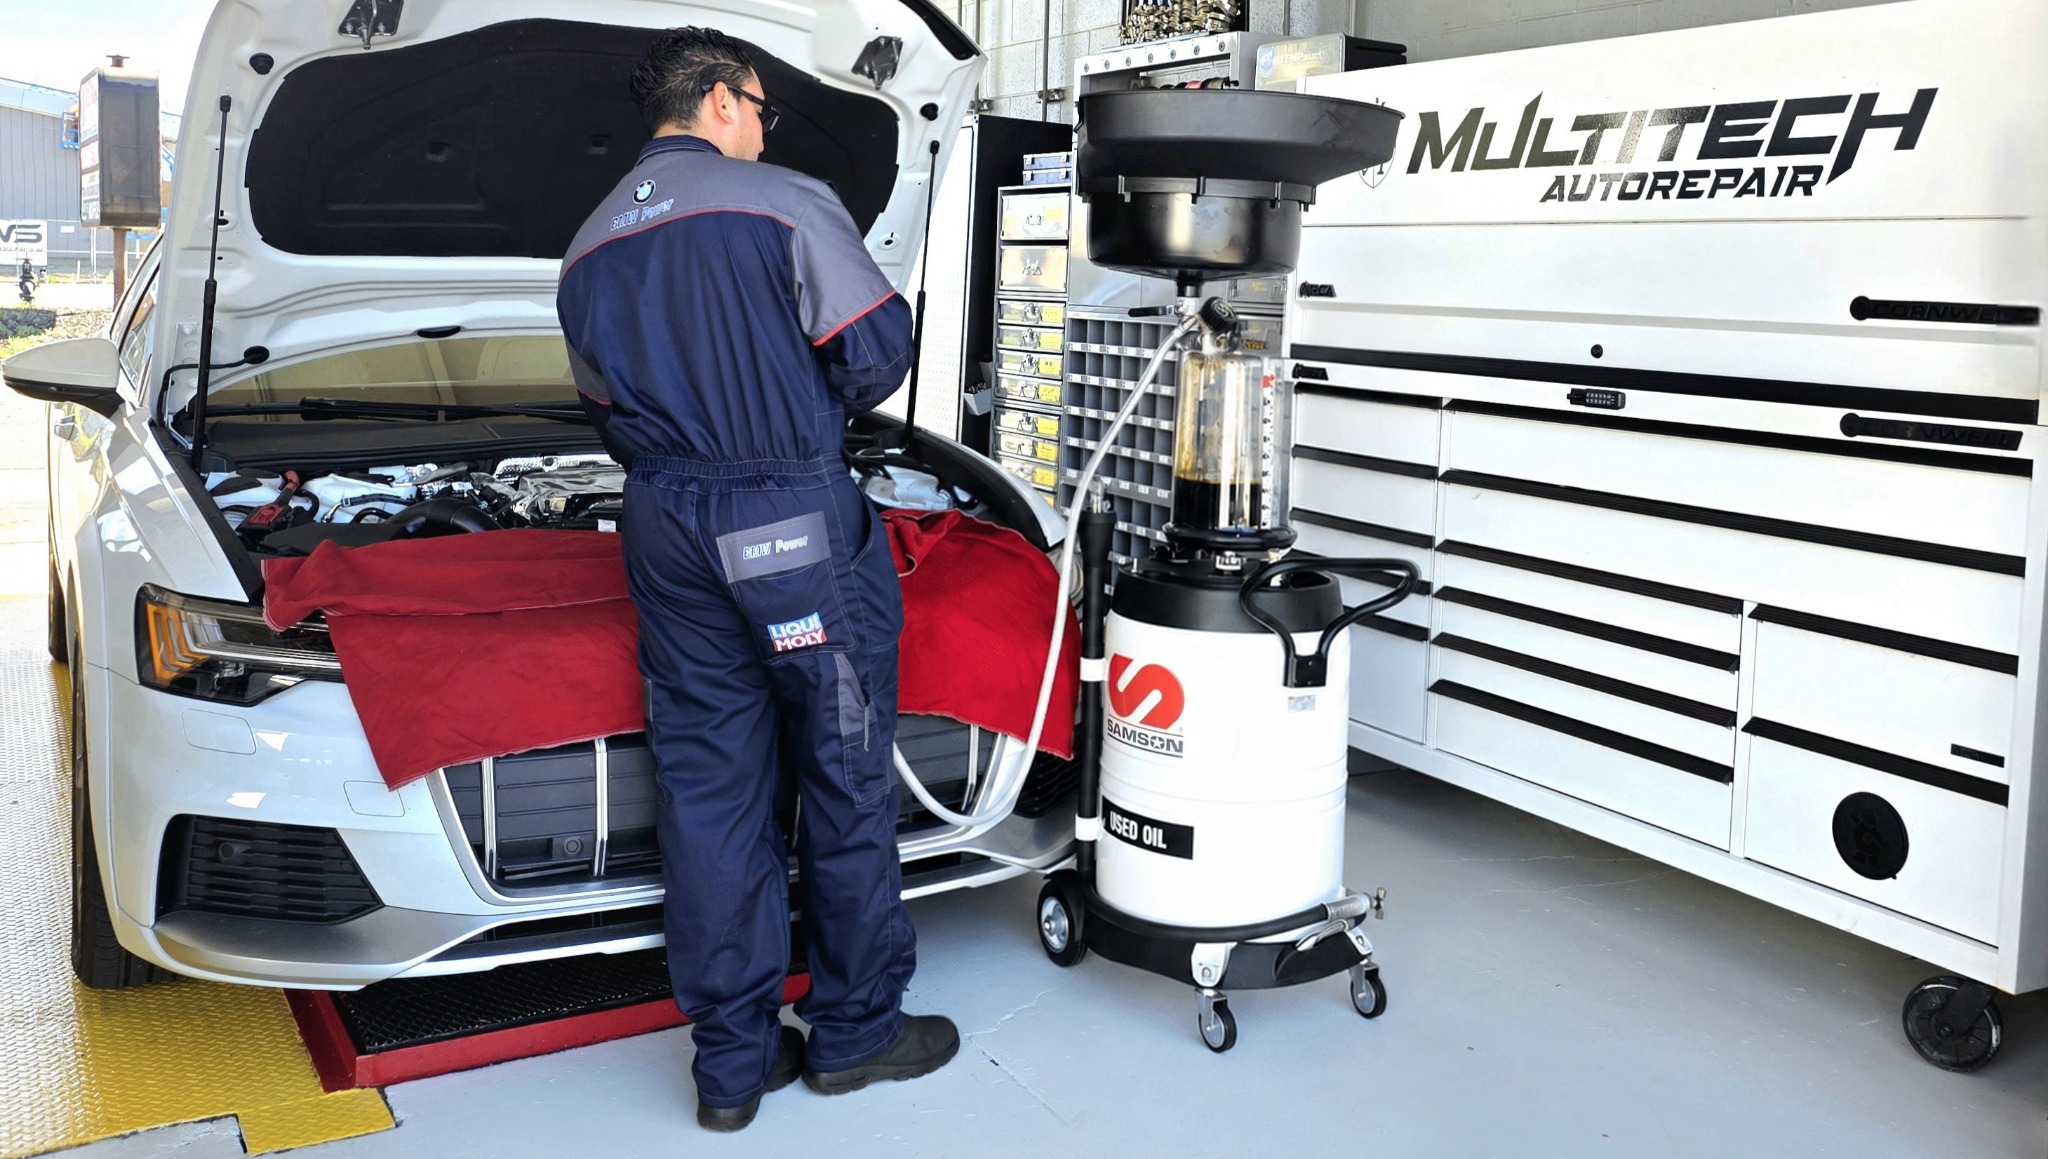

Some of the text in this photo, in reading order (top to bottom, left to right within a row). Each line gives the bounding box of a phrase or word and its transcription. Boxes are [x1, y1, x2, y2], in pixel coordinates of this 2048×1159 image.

[1406, 88, 1938, 186] MULTITECH
[1539, 165, 1824, 203] AUTOREPAIR
[610, 198, 674, 231] BMW Power
[1873, 302, 2029, 325] CORNWE
[742, 535, 808, 560] BMW Power
[770, 615, 820, 638] LIQUI
[775, 628, 823, 652] MOLY
[1107, 718, 1184, 754] SAMSON
[1110, 811, 1167, 849] USED OIL
